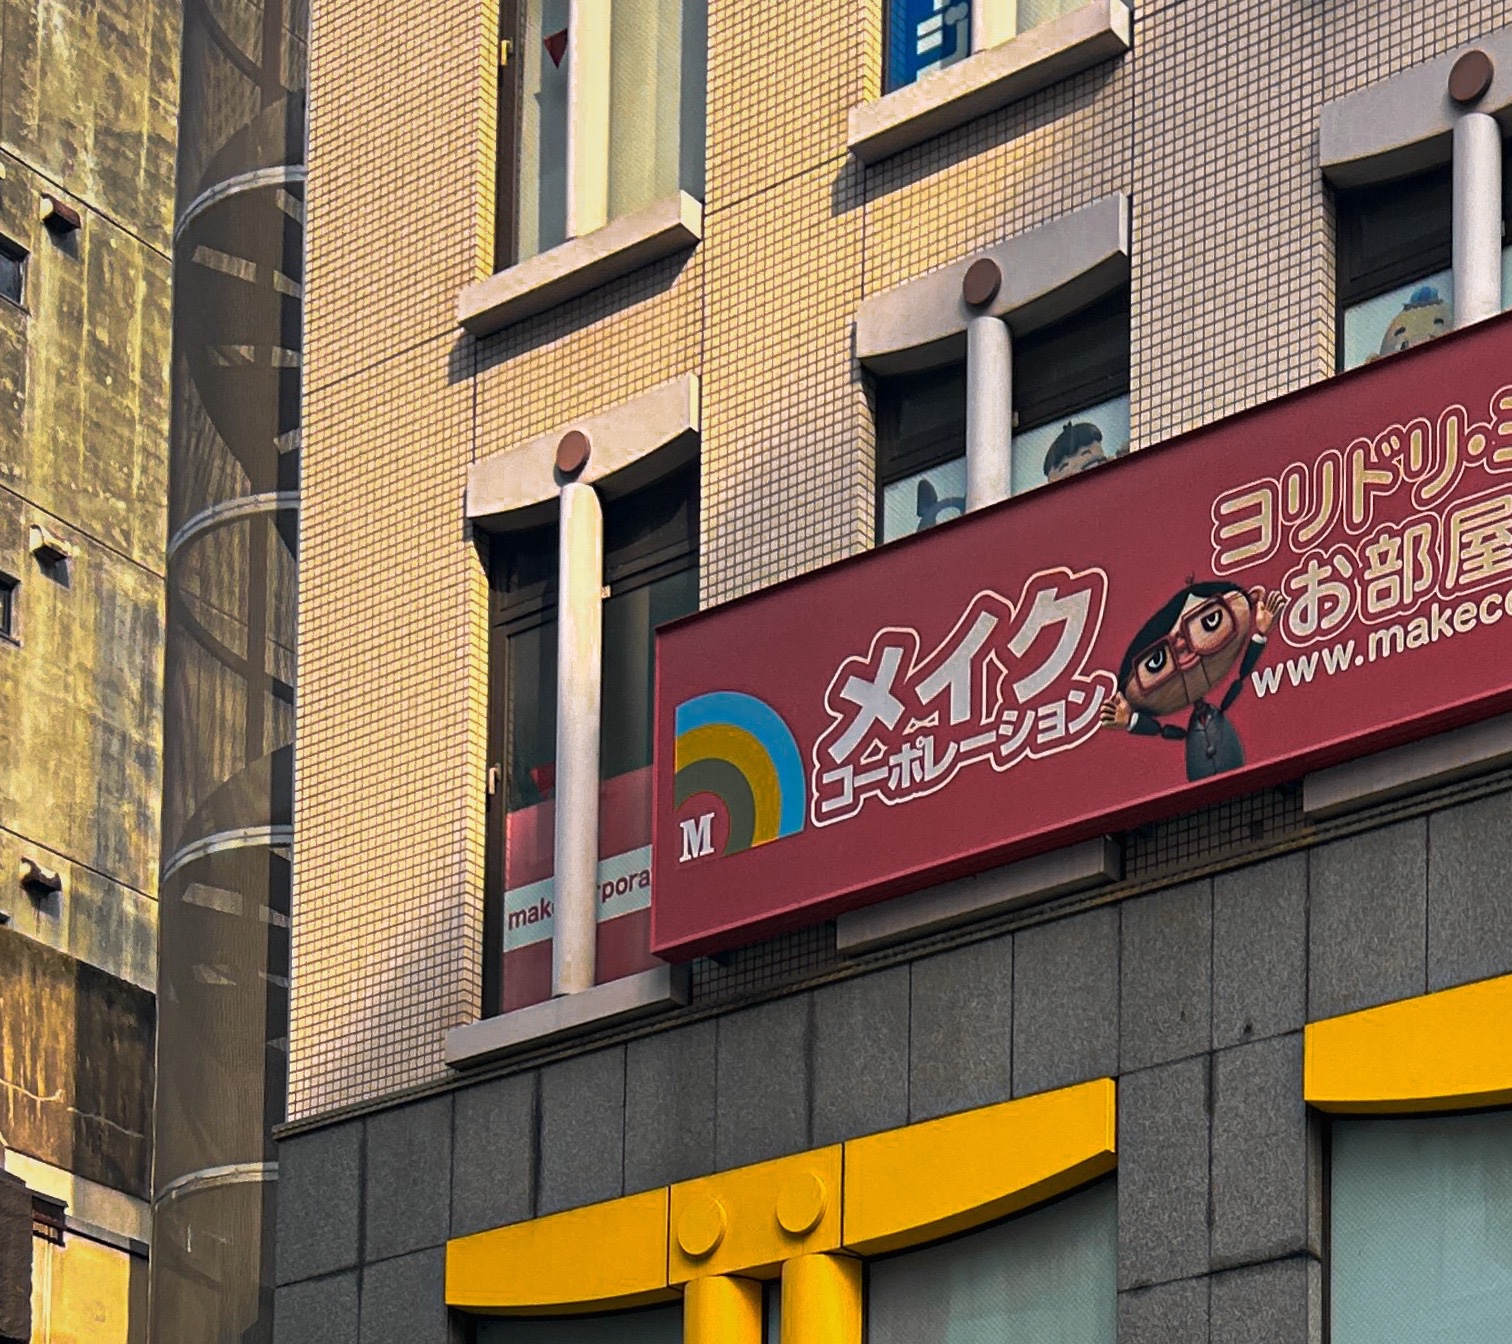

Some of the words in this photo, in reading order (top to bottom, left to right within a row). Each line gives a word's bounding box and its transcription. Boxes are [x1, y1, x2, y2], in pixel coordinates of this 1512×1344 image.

[828, 586, 1093, 763] メイク
[822, 683, 1107, 813] コーポレーション
[508, 897, 554, 930] mak
